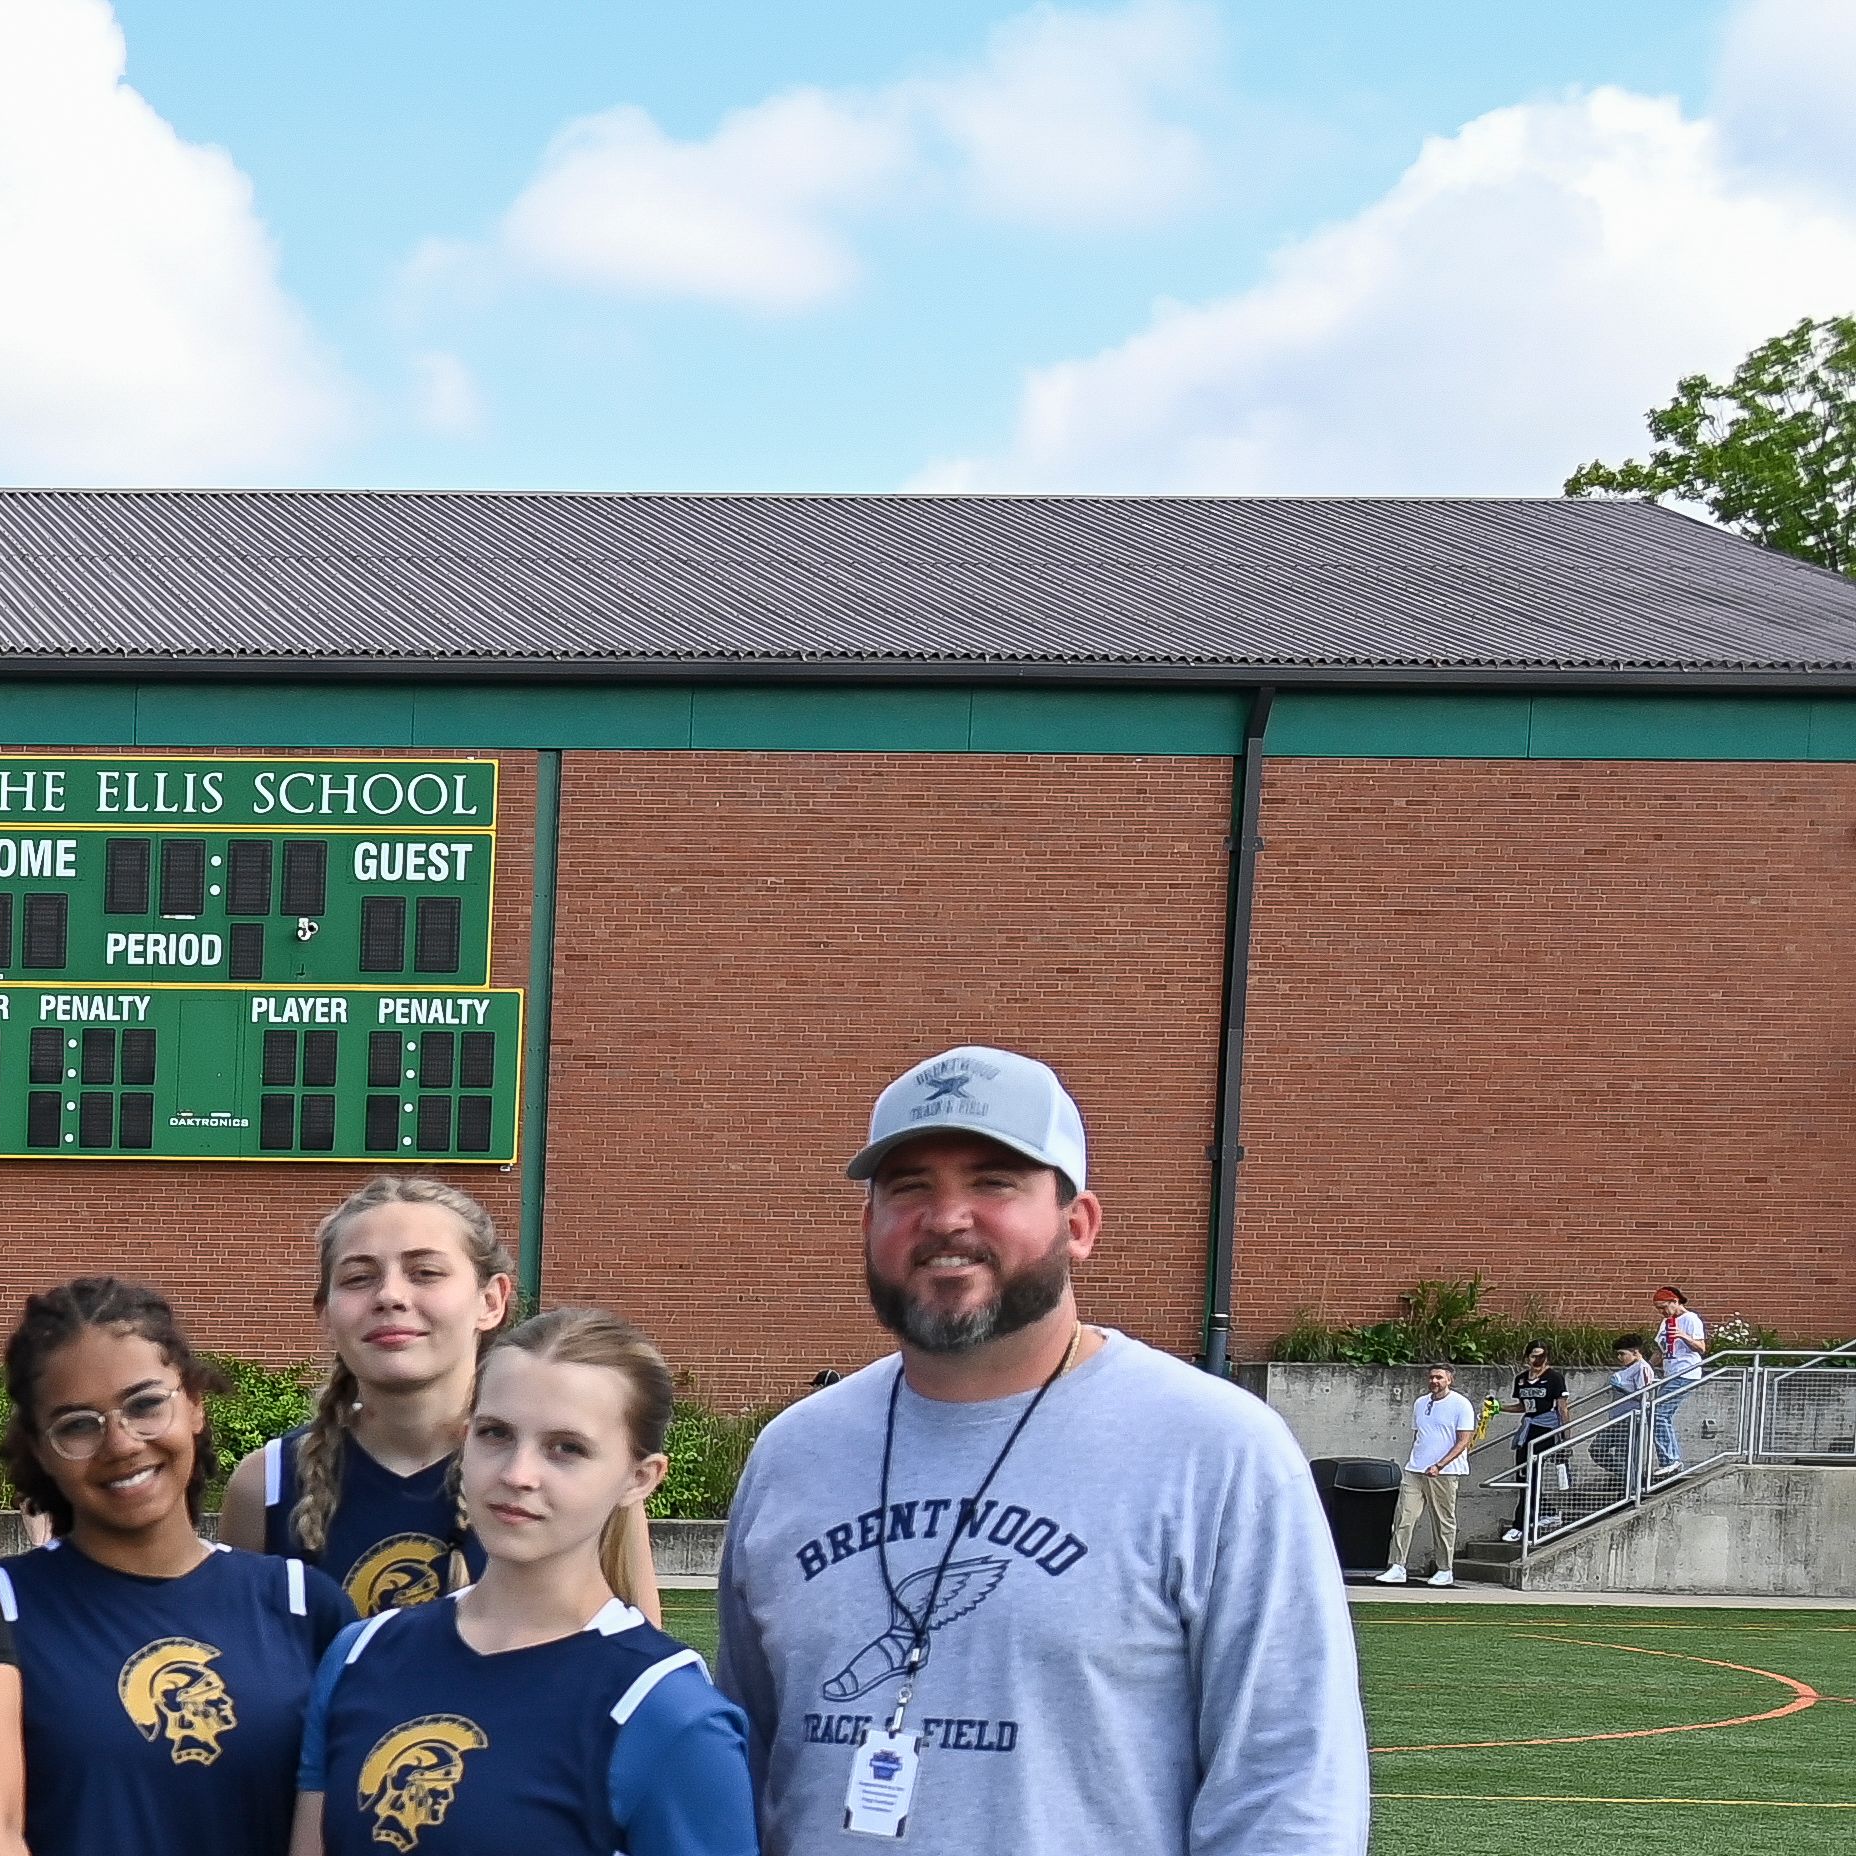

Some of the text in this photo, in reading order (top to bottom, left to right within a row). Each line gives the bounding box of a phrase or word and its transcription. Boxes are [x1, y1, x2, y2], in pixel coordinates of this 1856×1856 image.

[96, 771, 223, 814] ELLIS
[253, 772, 478, 815] SCHOOL
[354, 841, 473, 882] GUEST
[106, 932, 222, 966] PERIOD
[39, 994, 151, 1021] PENALTY
[251, 996, 490, 1025] PLAYER PENALTY
[169, 1117, 249, 1127] DAKTRONICS
[796, 1497, 1088, 1581] BRENTWOOD
[803, 1713, 873, 1746] RACK
[921, 1717, 1019, 1752] FIELD
